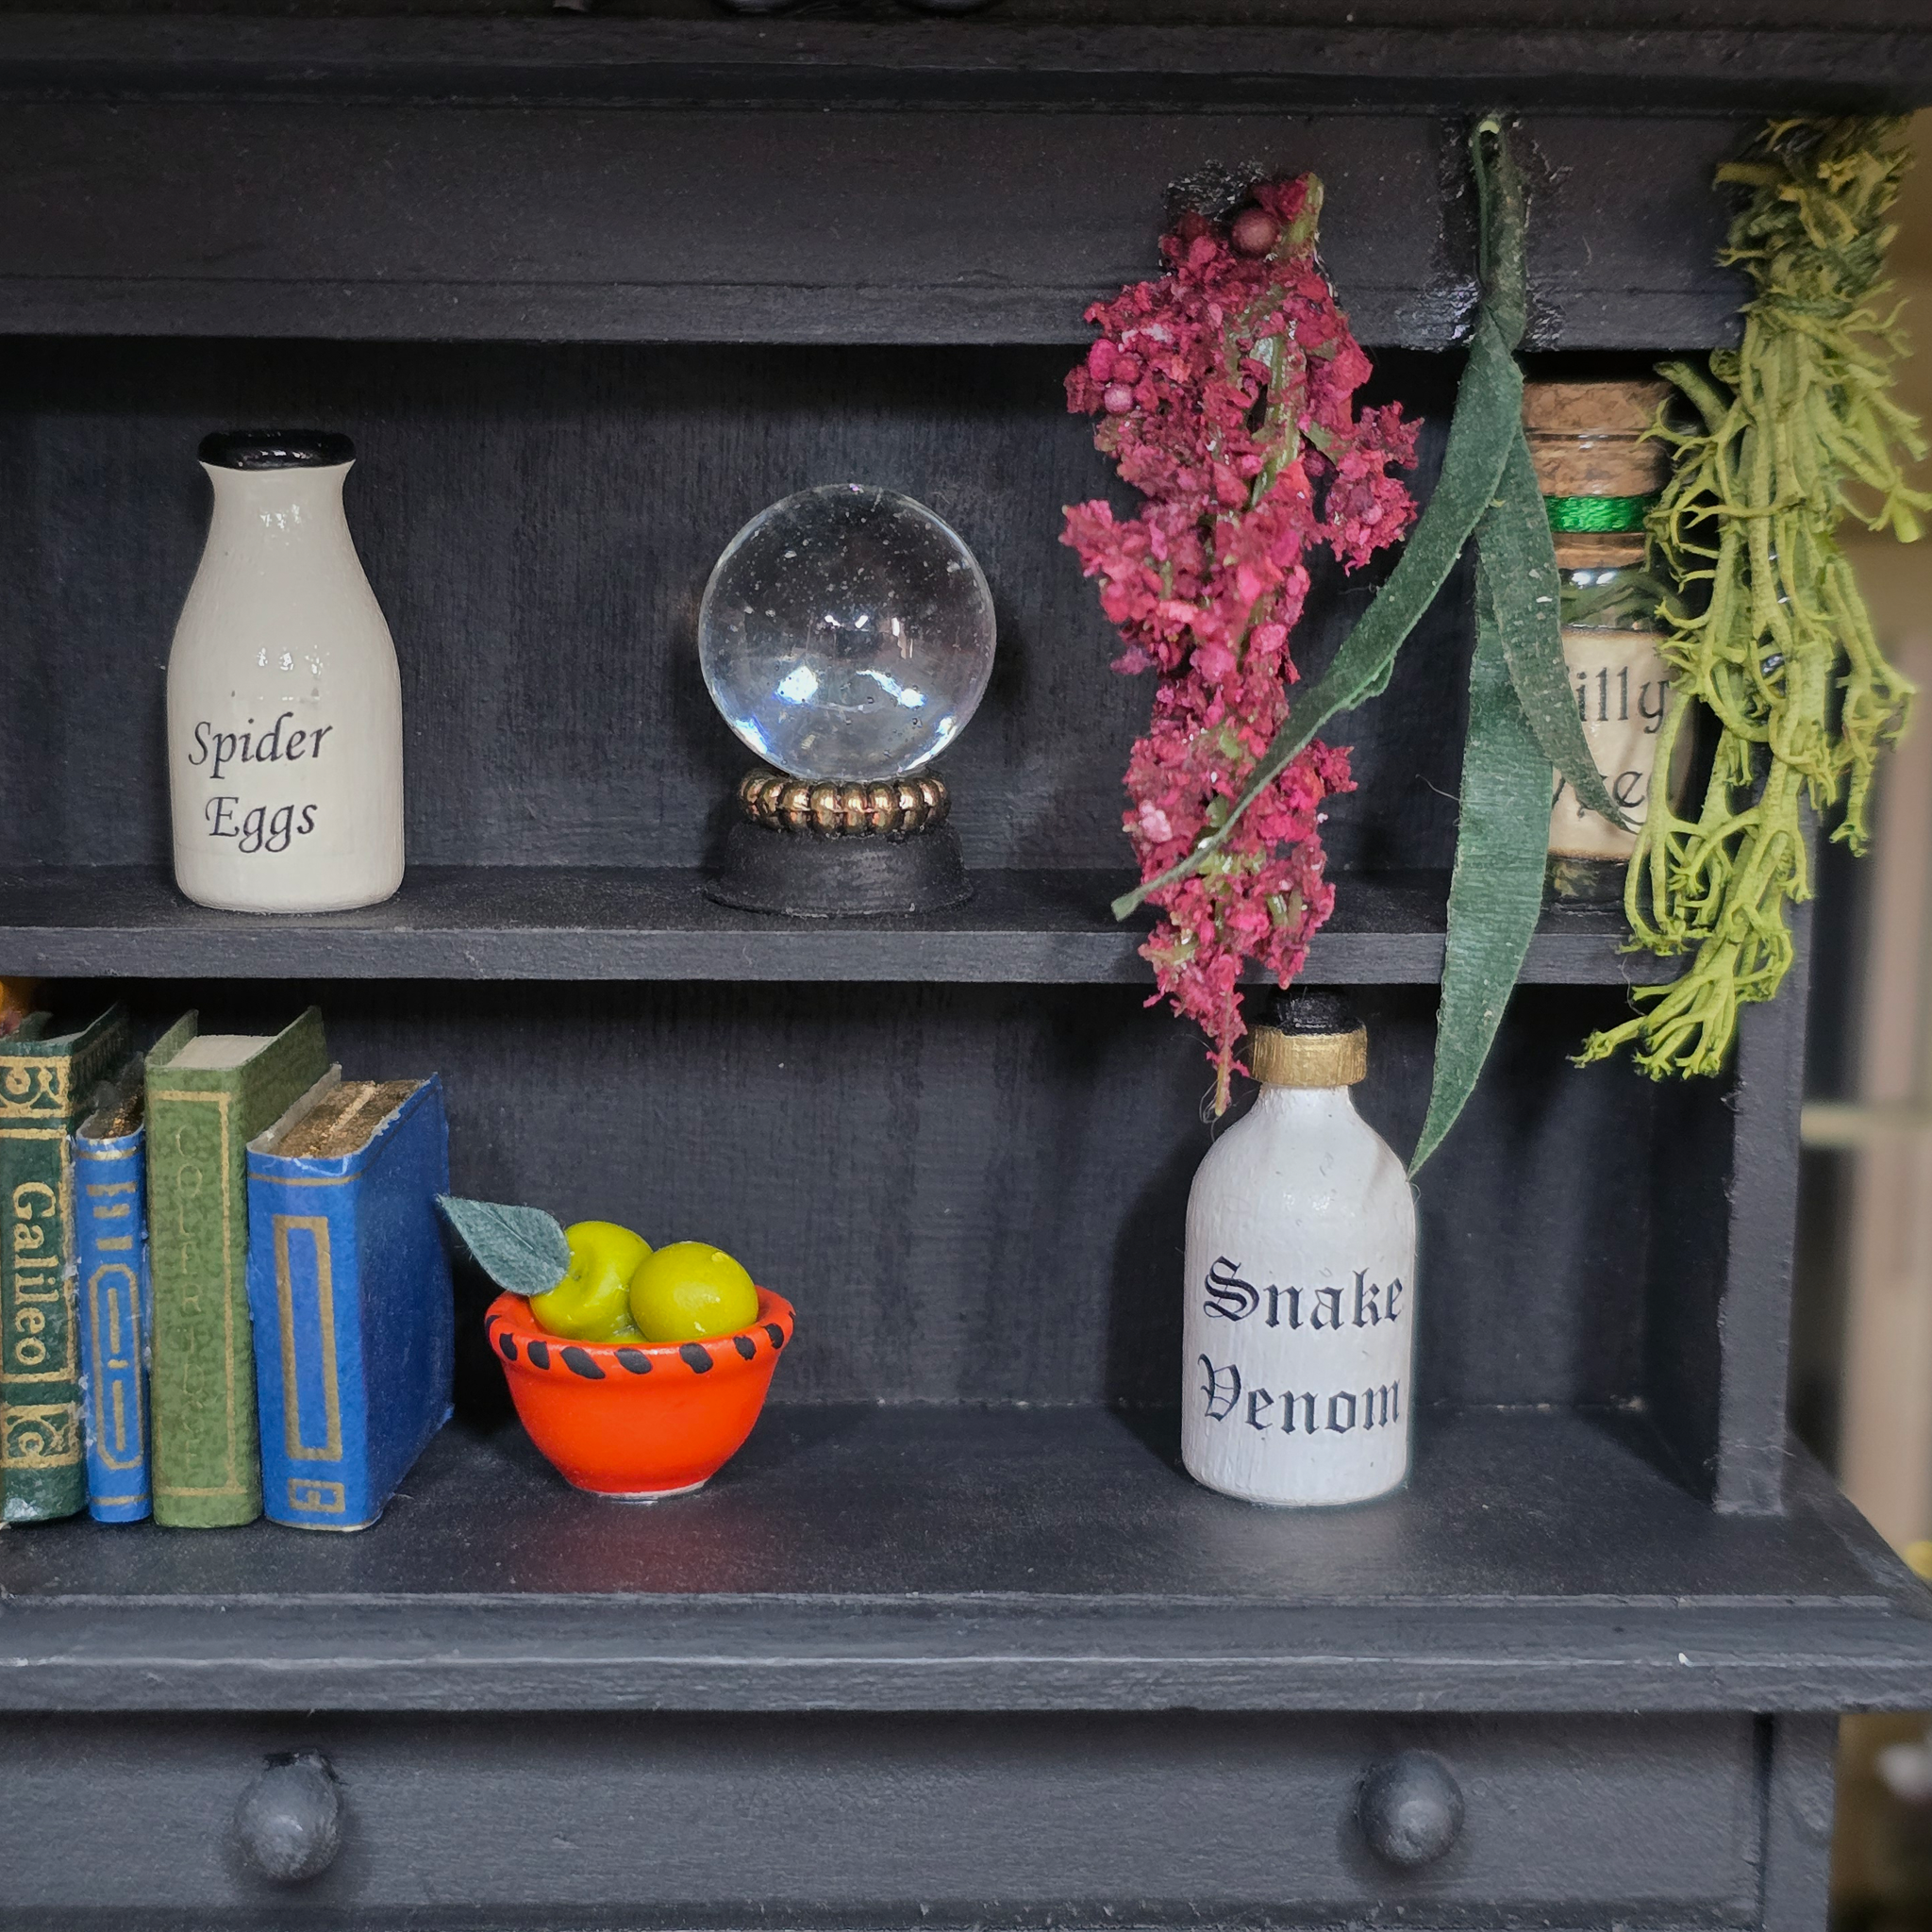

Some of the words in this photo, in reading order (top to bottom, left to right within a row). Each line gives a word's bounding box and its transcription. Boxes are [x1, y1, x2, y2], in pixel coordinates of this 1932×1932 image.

[1573, 665, 1671, 735] illy
[188, 711, 334, 780] Spider
[204, 795, 319, 855] Eggs
[12, 1181, 59, 1365] Galileo
[1203, 1256, 1404, 1331] Snake
[1197, 1353, 1401, 1436] Venom
